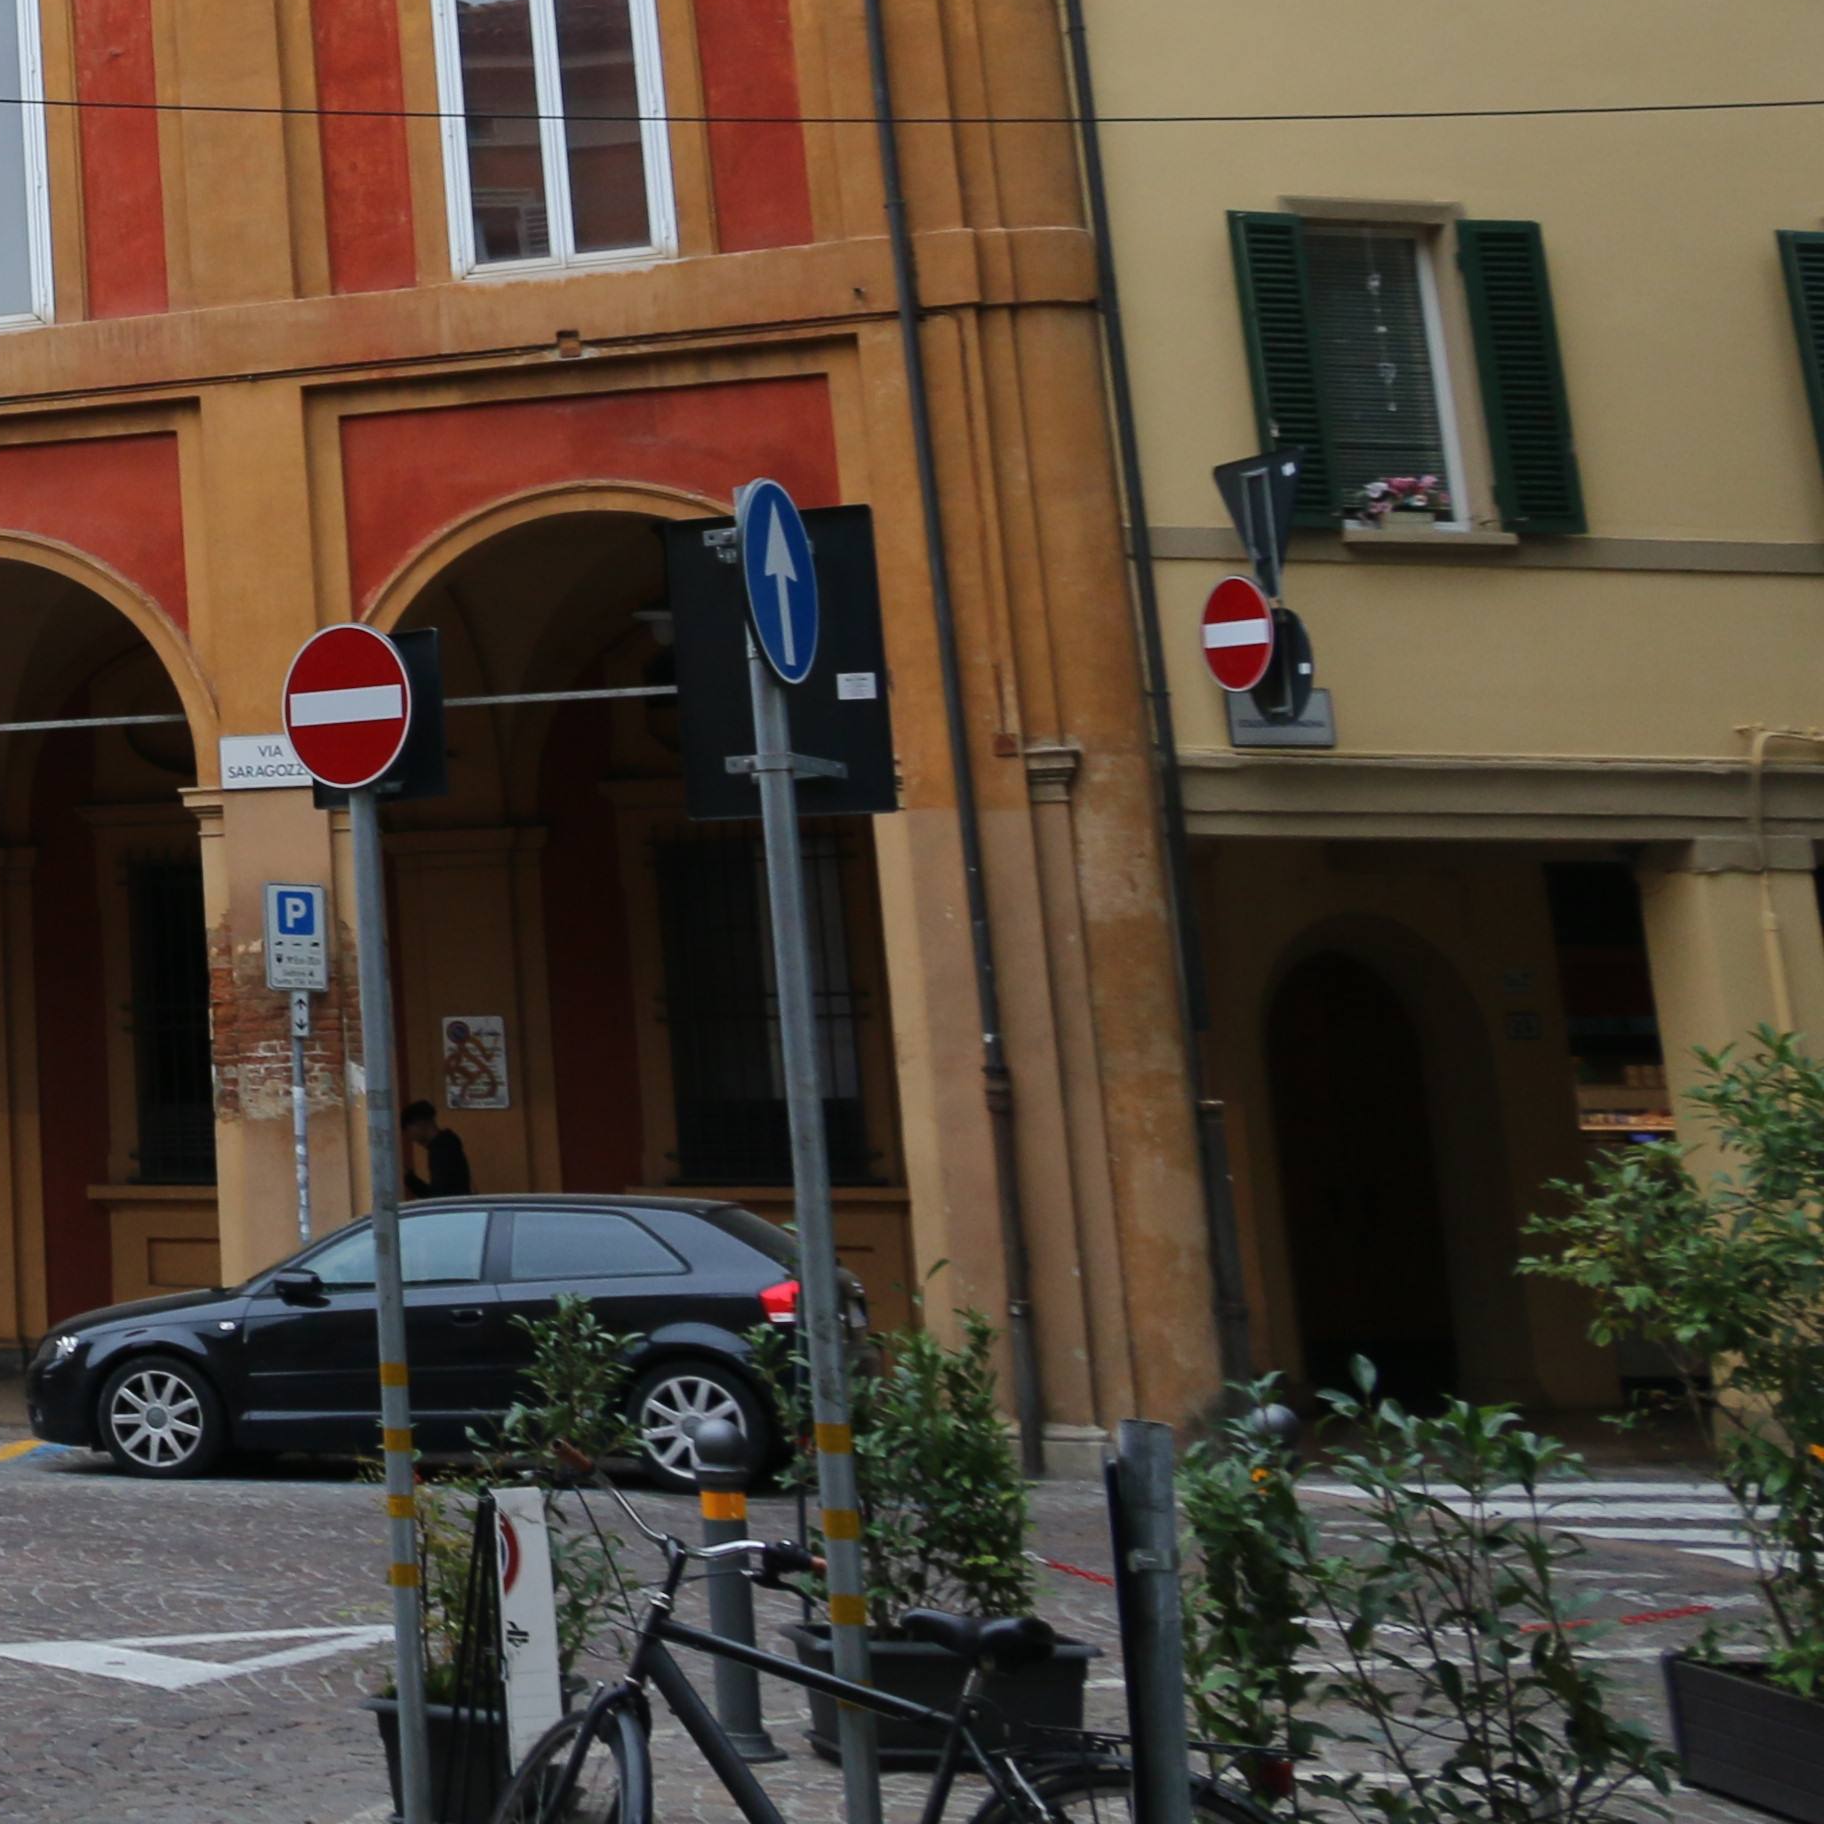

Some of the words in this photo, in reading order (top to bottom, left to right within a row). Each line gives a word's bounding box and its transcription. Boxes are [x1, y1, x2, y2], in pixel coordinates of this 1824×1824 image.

[257, 745, 284, 757] VIA
[228, 763, 310, 779] SARAGOZZ
[285, 897, 307, 928] P
